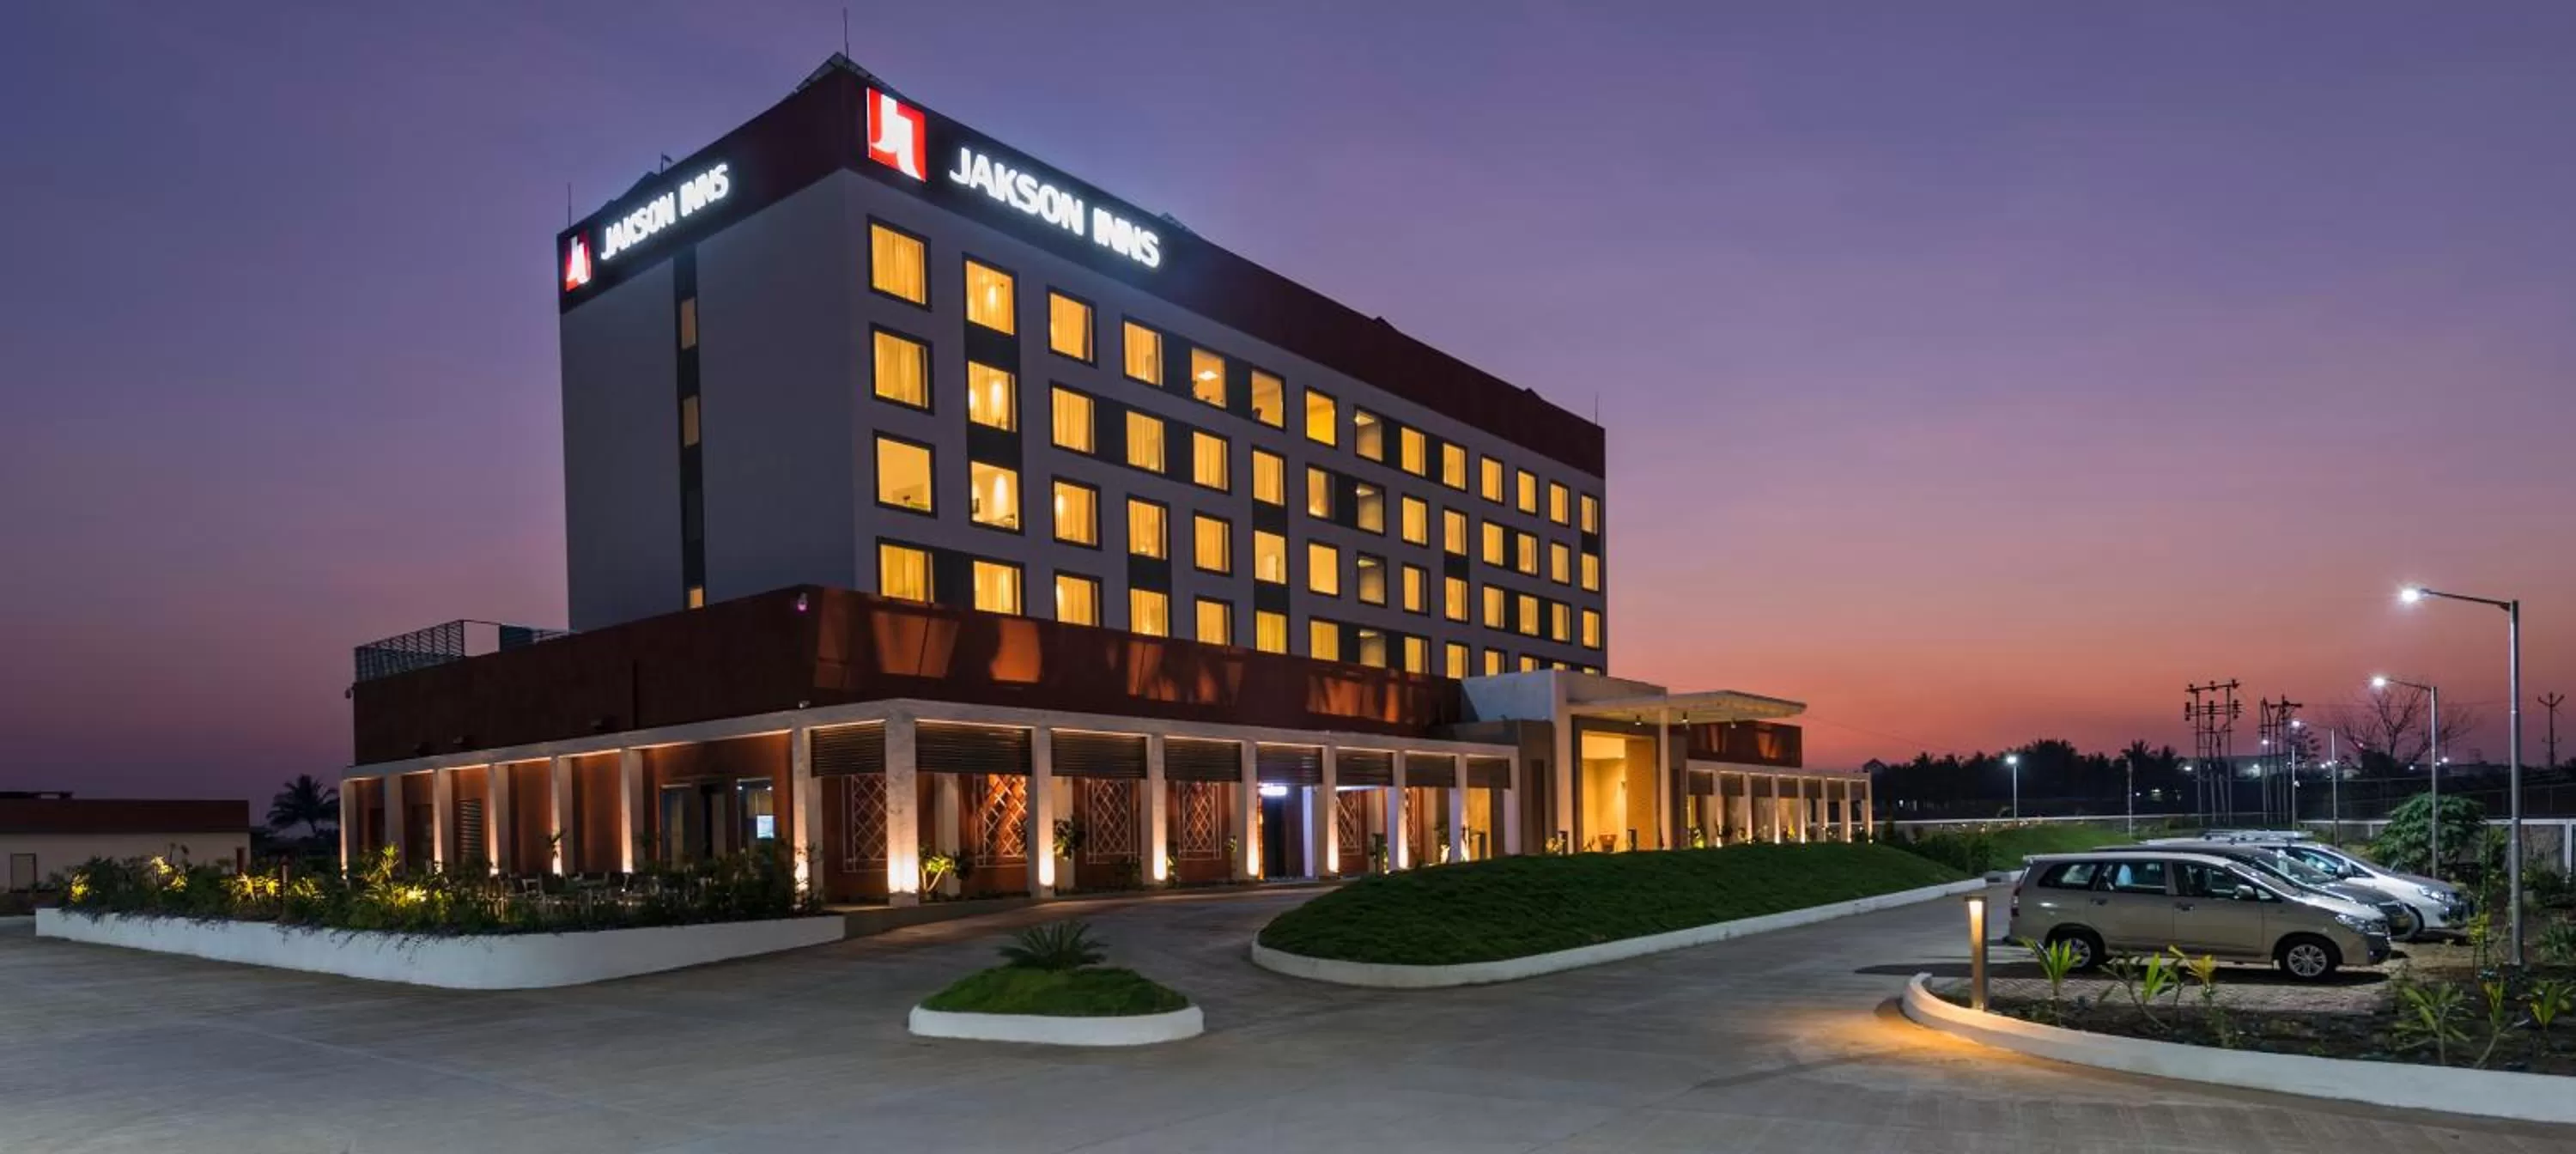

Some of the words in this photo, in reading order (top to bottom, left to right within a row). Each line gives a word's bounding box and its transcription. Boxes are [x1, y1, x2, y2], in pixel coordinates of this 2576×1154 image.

[600, 191, 676, 260] JAKSON
[679, 163, 730, 217] INNS
[950, 147, 1084, 236] JAKSON
[1093, 208, 1160, 268] INNS
